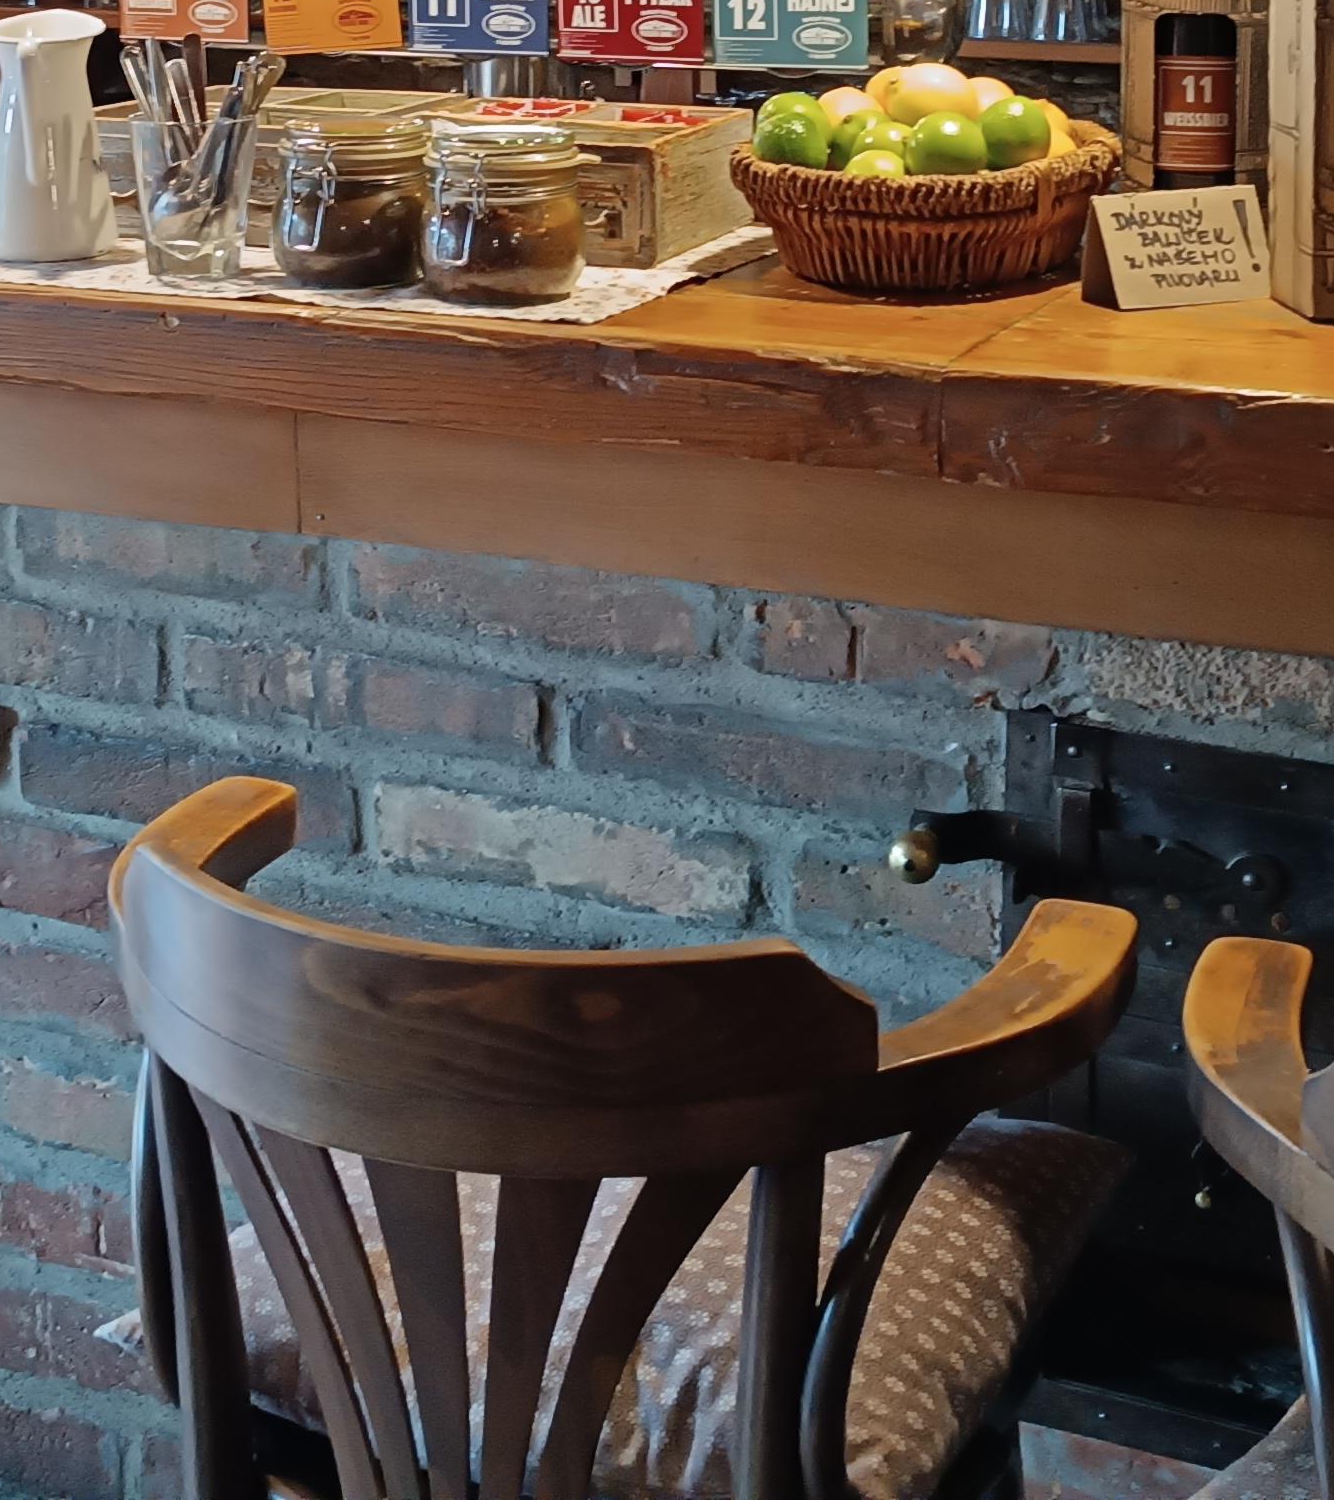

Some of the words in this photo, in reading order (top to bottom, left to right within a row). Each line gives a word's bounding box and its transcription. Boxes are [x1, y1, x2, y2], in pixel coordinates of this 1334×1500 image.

[571, 5, 606, 28] ALE
[1181, 75, 1213, 104] 11
[1110, 197, 1203, 231] DÁRKOVÝ
[1147, 246, 1237, 268] NAŠEHO
[1150, 270, 1241, 289] PIVOVARU
